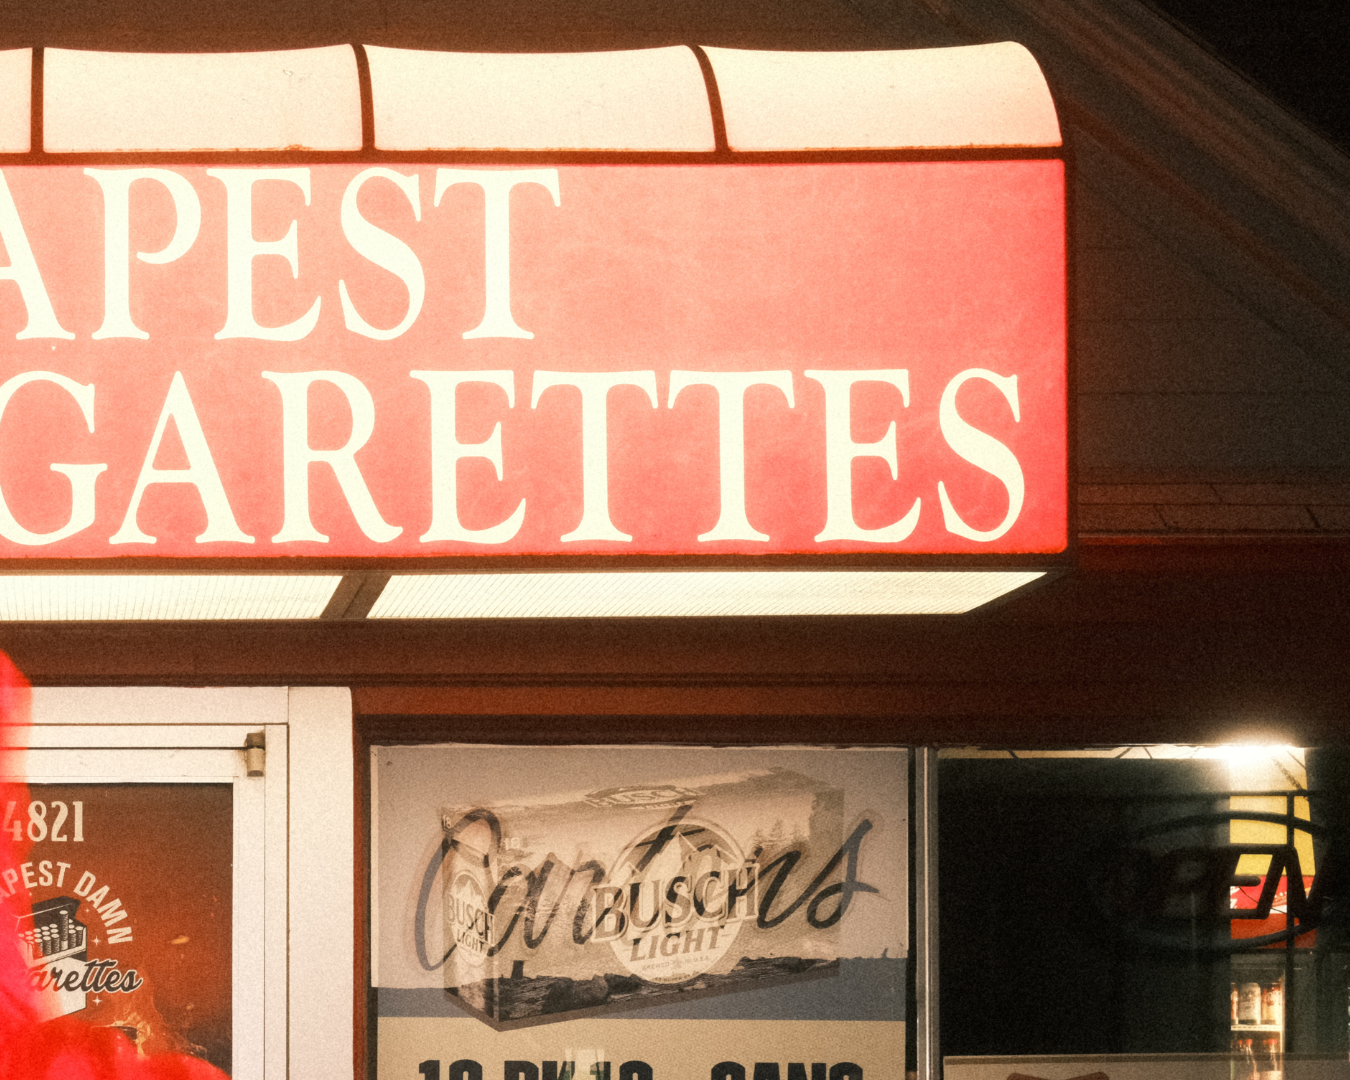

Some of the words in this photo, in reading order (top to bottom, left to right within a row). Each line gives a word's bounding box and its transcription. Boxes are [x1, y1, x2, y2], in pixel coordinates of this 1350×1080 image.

[2, 800, 84, 842] 4821
[73, 870, 133, 945] DAMN
[445, 891, 496, 947] BUSCH
[590, 862, 761, 944] BUSCH
[456, 928, 484, 954] LIGHT
[629, 925, 728, 961] LIGHT
